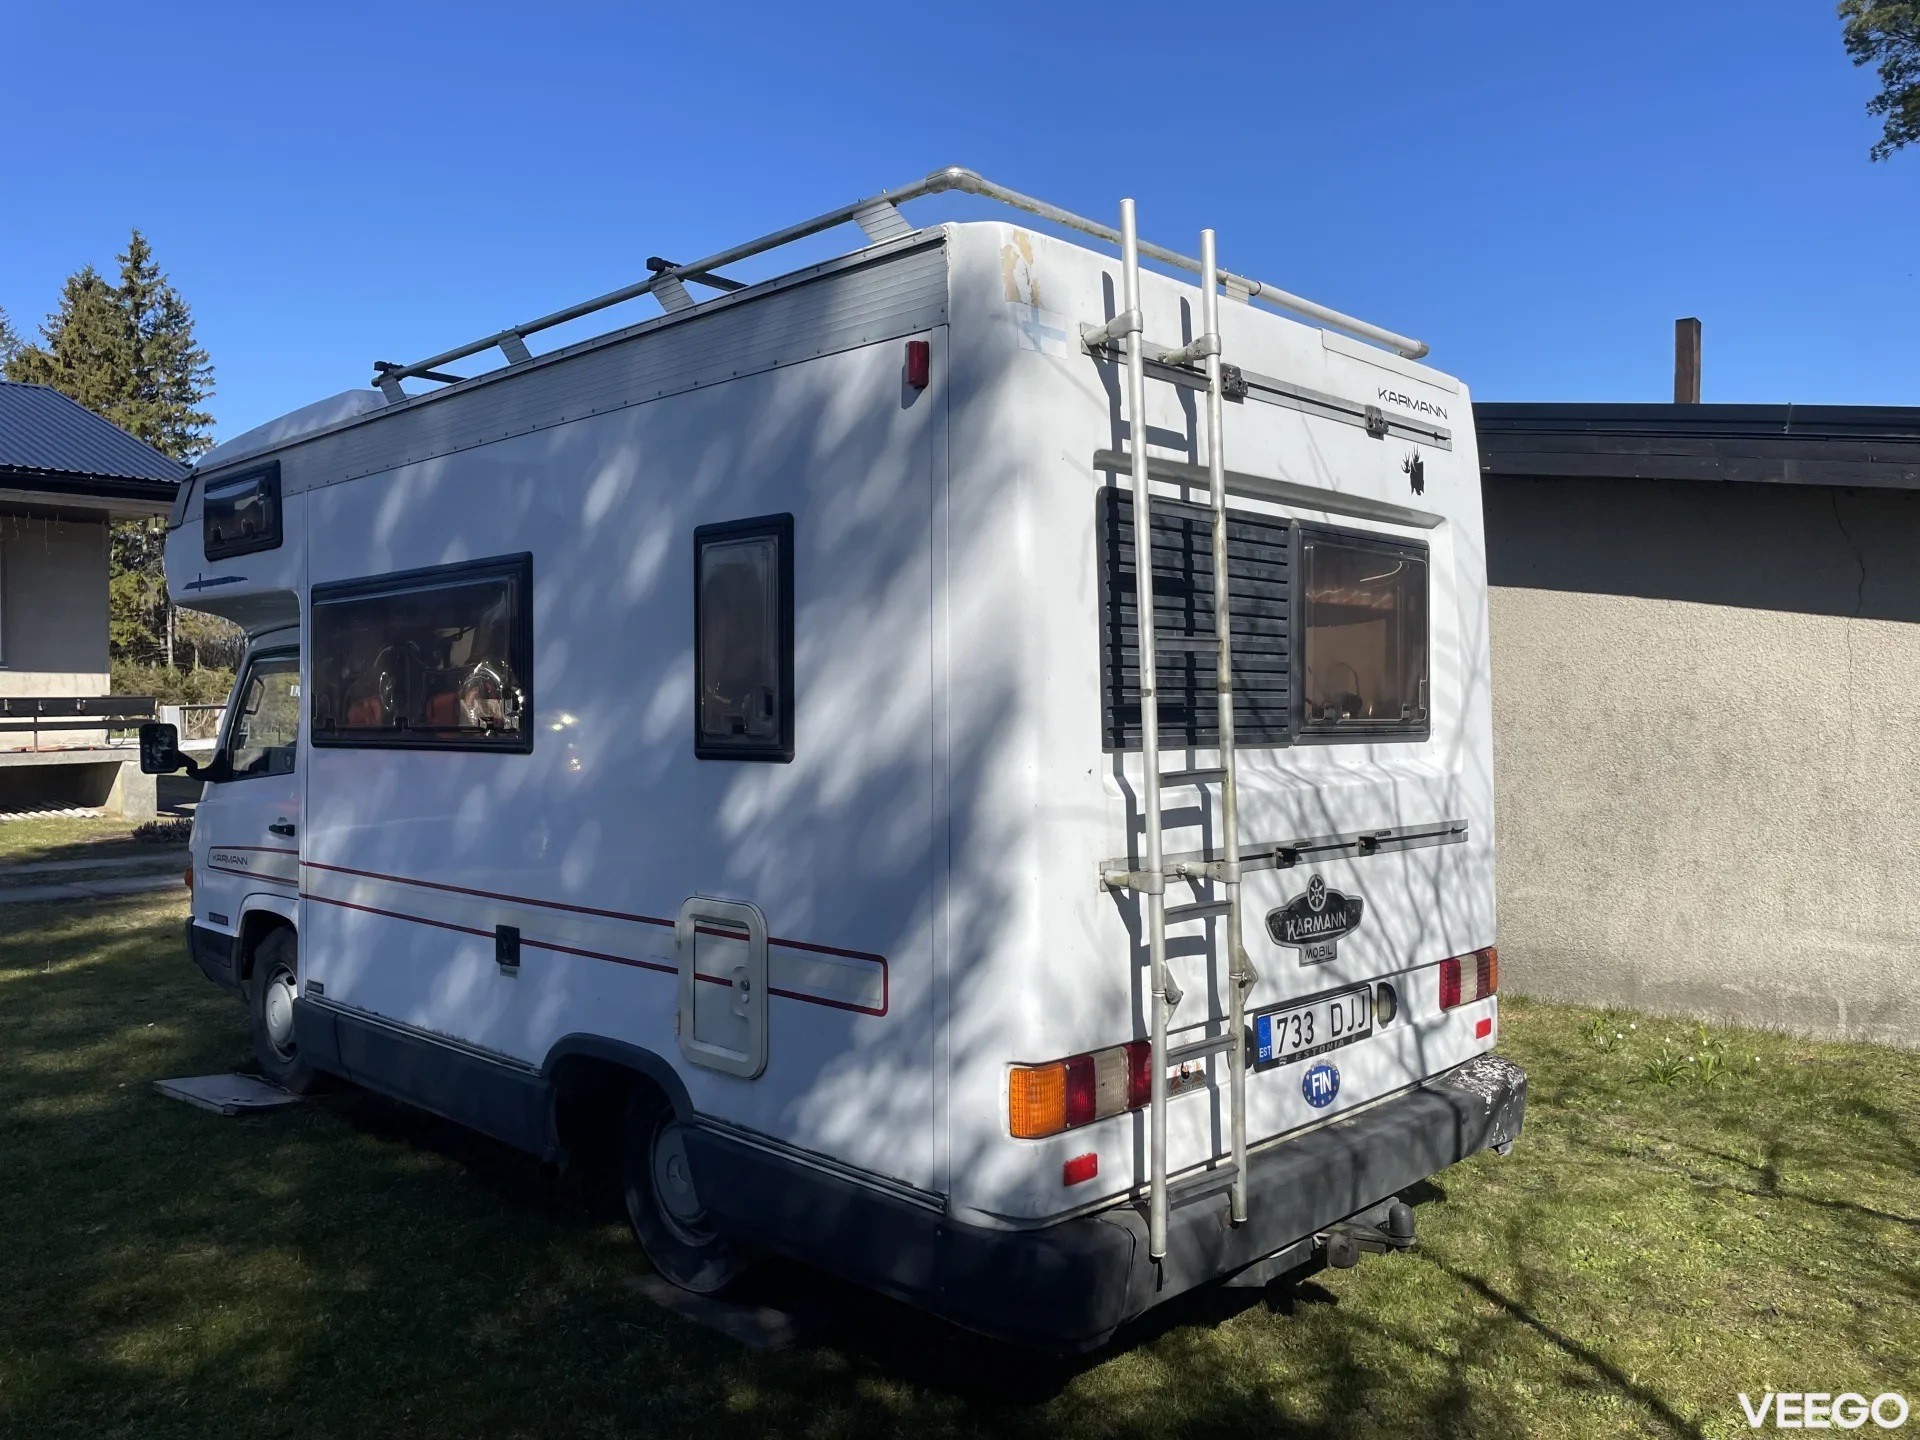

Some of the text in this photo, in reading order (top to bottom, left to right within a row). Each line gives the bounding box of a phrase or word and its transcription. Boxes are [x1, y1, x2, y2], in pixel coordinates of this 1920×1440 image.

[1378, 387, 1448, 420] KARMANN
[212, 853, 248, 866] KARMANN
[1286, 911, 1347, 941] KARMANN
[1305, 945, 1333, 960] MOBIL
[1277, 995, 1366, 1054] 733 DJJ
[1259, 1045, 1272, 1058] EST
[1295, 1040, 1345, 1061] ESTONIA
[1311, 1069, 1333, 1098] FIN
